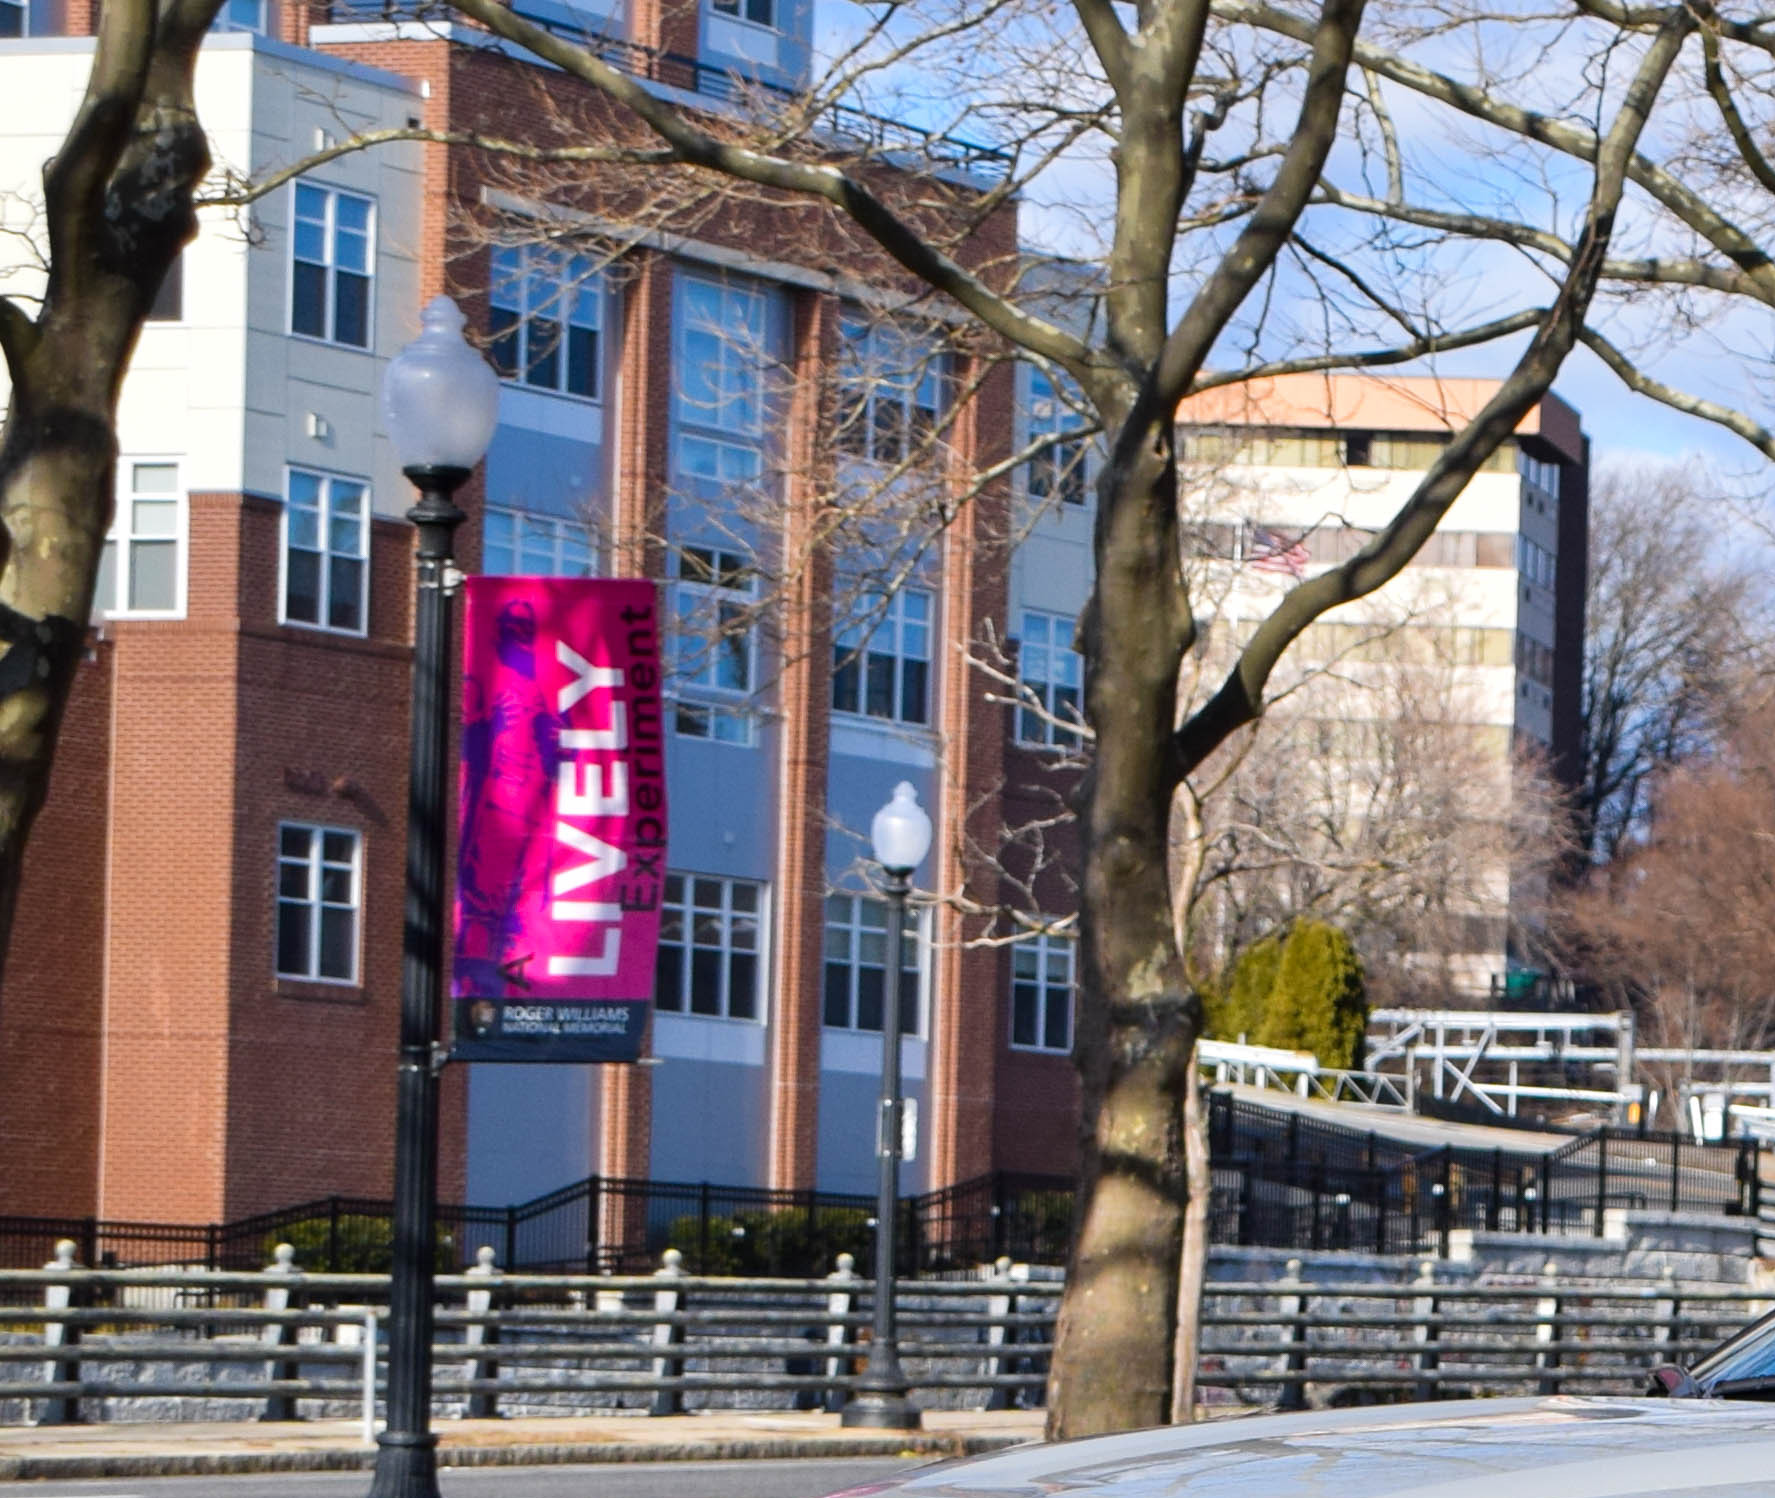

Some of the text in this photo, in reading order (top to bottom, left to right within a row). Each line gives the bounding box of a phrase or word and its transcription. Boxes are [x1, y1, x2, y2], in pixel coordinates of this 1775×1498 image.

[620, 605, 664, 913] Experiment
[548, 640, 629, 976] LIVELY
[501, 951, 534, 991] A
[502, 1021, 626, 1034] NATIONAL MEMORIAL
[503, 1005, 630, 1022] ROGER WILLIAMS
